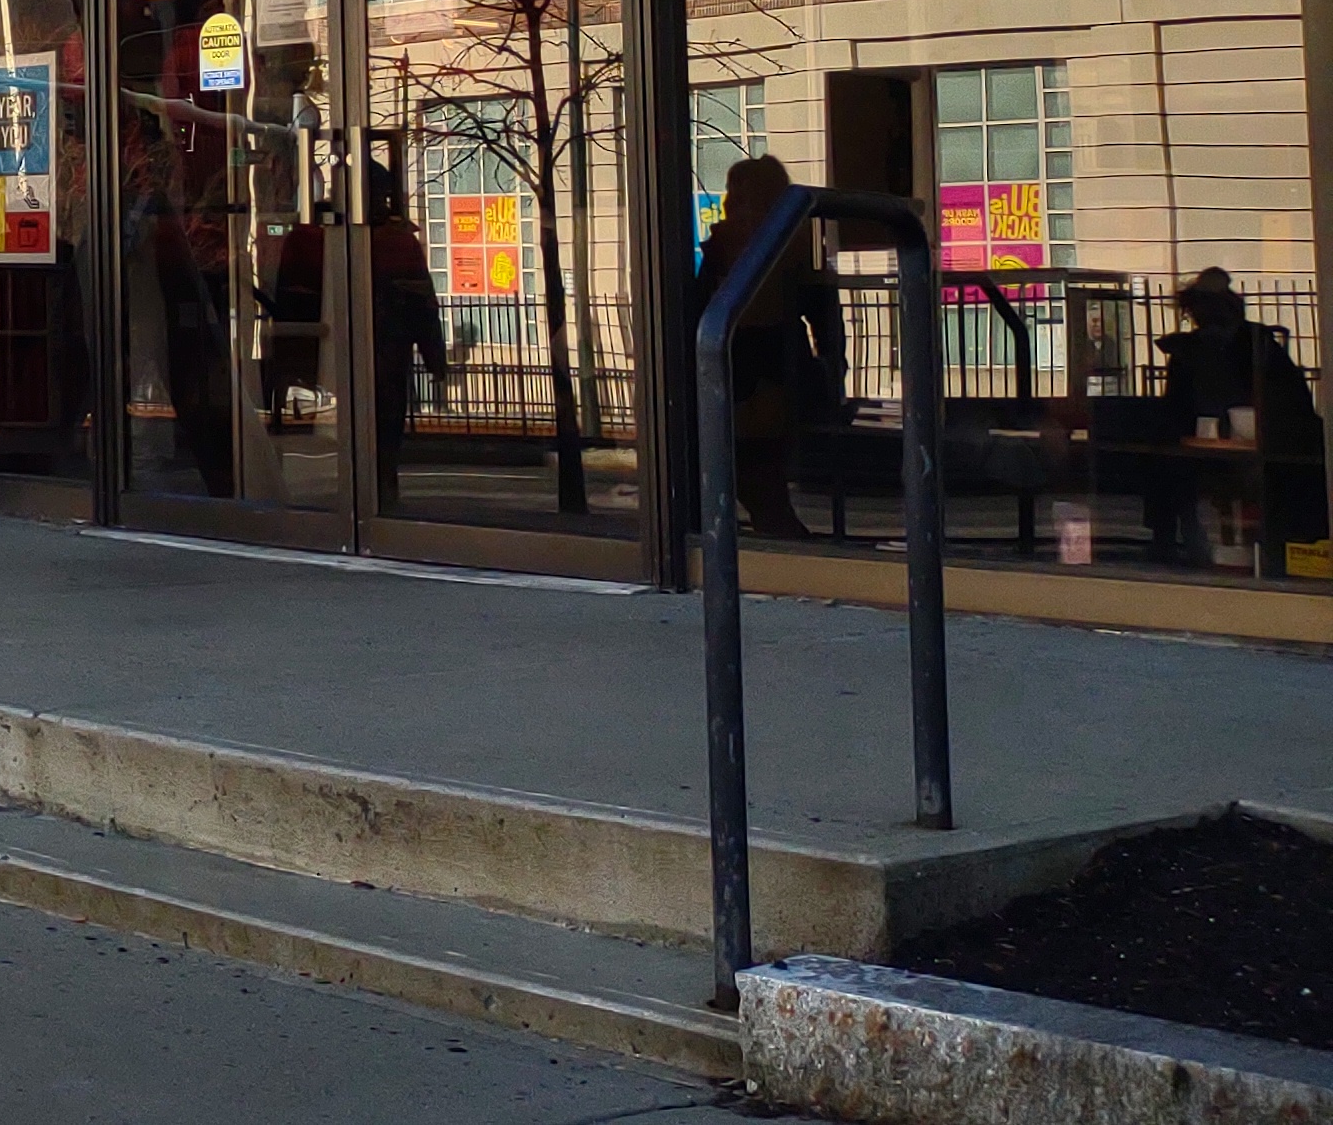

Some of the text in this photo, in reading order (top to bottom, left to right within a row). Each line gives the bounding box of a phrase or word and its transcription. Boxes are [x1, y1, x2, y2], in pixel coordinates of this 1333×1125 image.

[202, 35, 240, 48] CAUTION
[212, 50, 230, 59] DOOR
[0, 125, 29, 149] YOU
